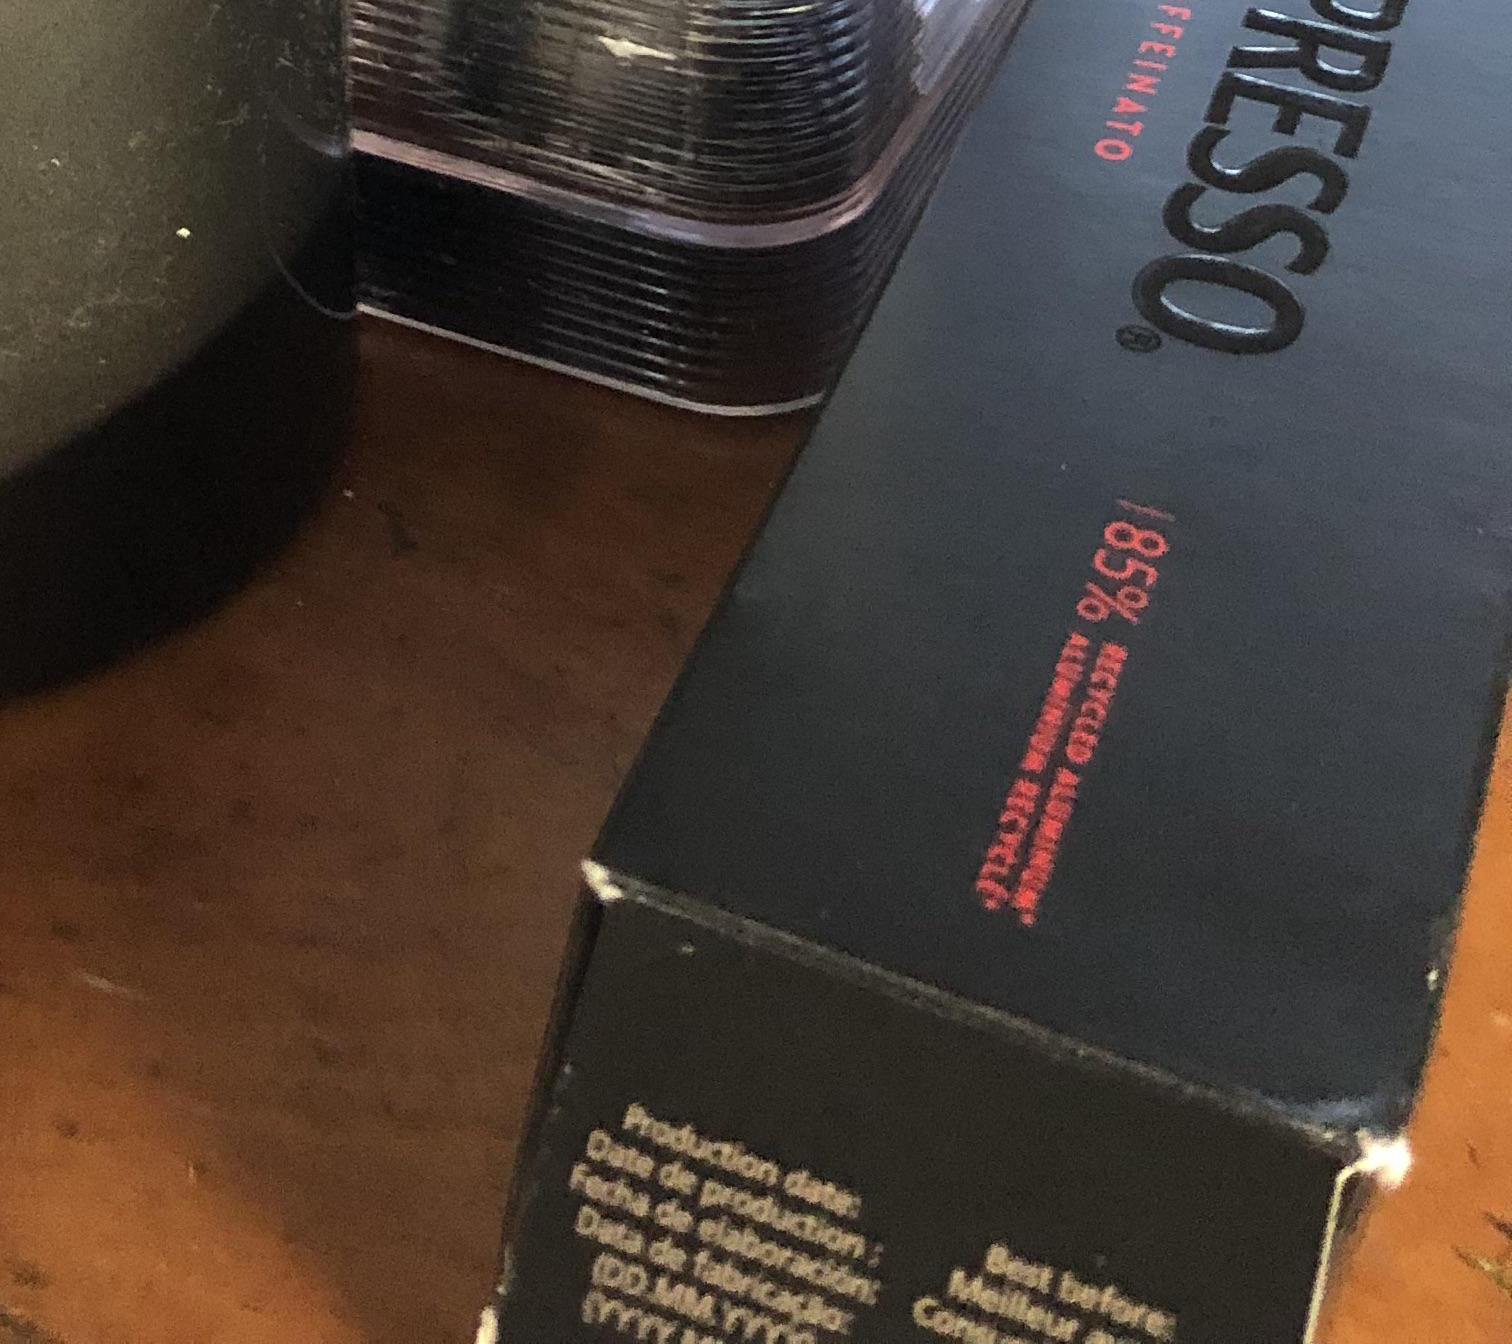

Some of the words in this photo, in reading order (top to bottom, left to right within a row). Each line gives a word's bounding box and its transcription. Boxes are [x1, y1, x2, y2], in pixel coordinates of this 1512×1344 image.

[1076, 520, 1170, 625] 85%
[622, 1103, 780, 1187] Production
[658, 1162, 698, 1196] de
